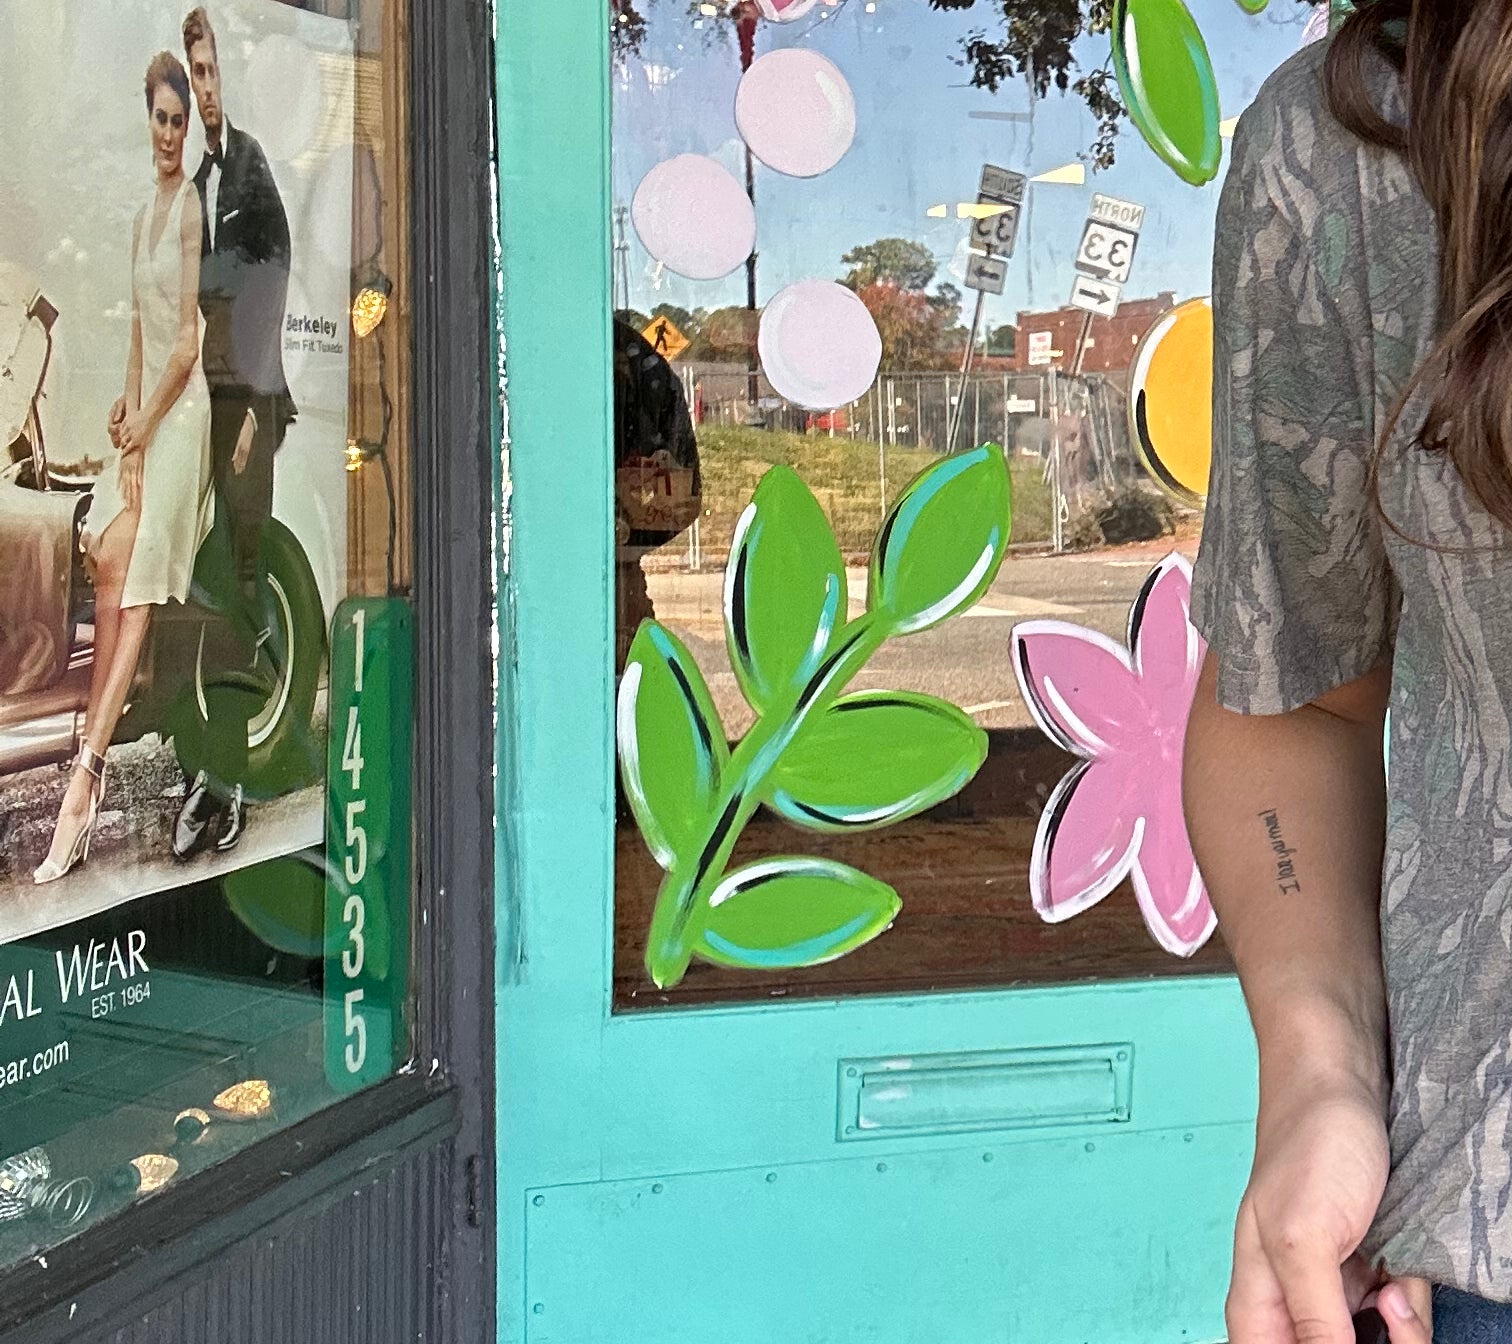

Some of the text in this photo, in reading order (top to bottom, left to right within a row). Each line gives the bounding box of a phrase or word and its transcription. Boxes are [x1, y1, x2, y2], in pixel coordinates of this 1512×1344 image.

[286, 314, 337, 339] Berkeley
[302, 339, 316, 352] Fit
[341, 608, 367, 1074] 14535
[56, 929, 150, 1004] WEAR
[91, 981, 151, 1019] EST. 1964
